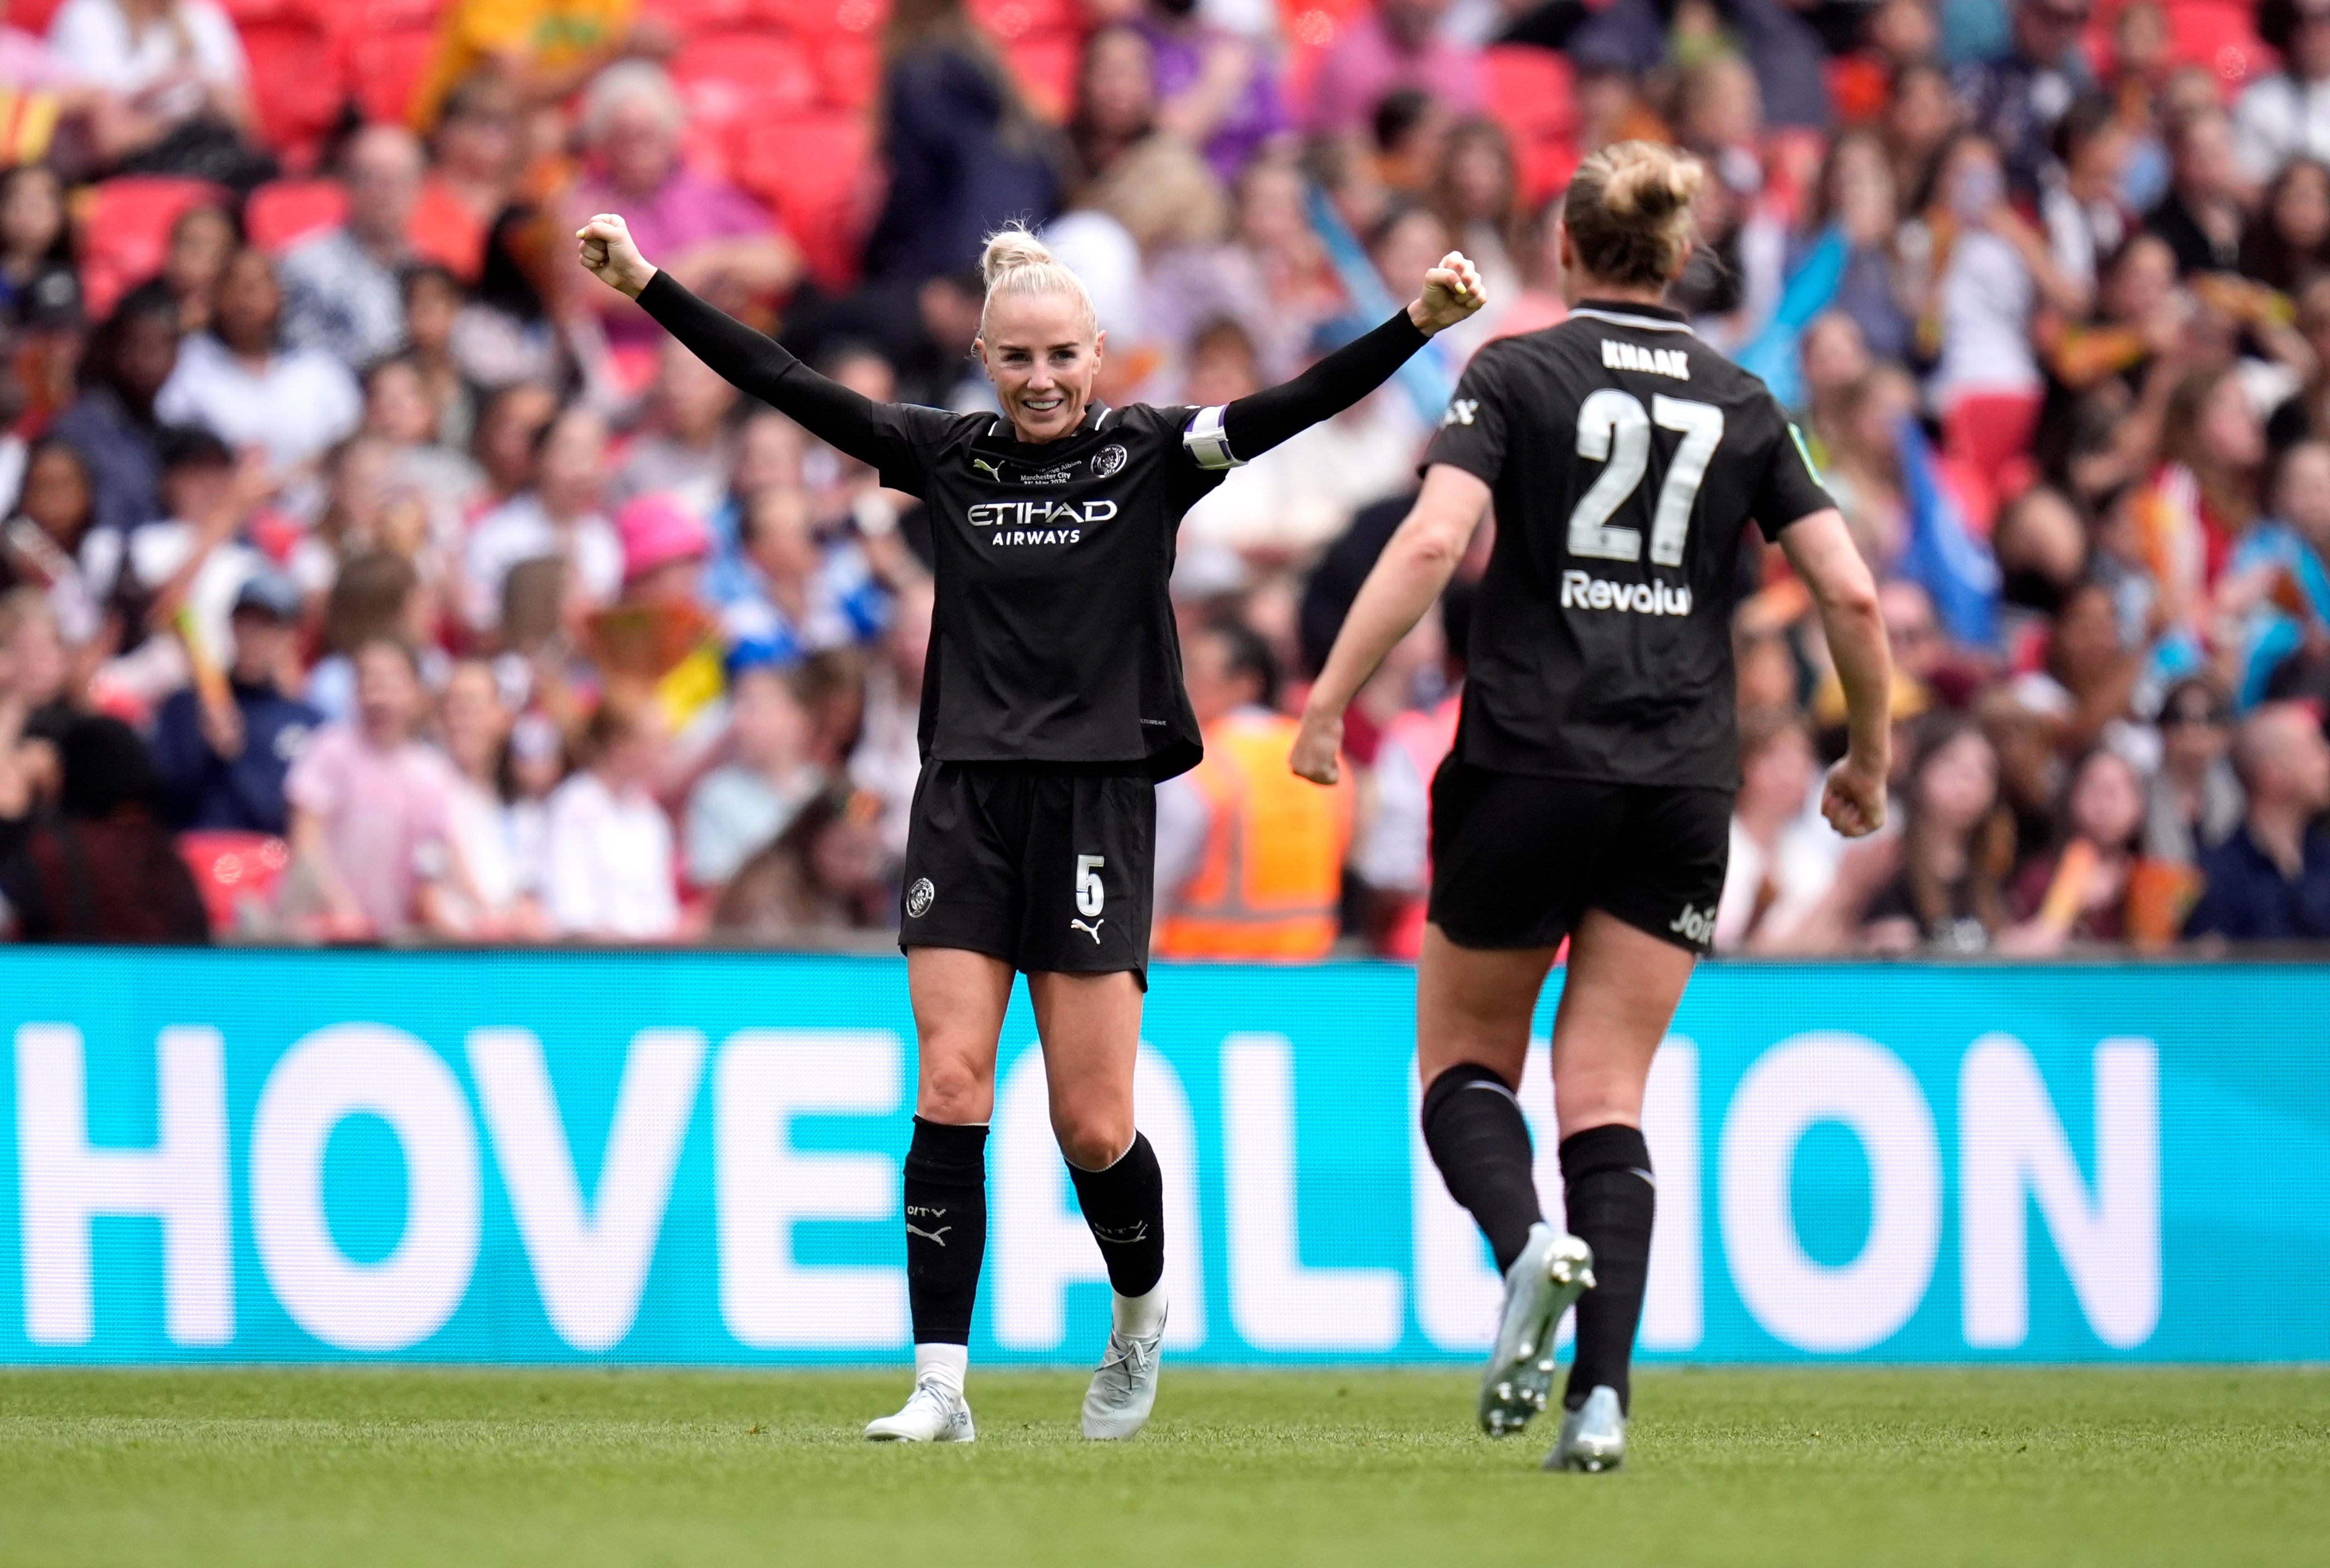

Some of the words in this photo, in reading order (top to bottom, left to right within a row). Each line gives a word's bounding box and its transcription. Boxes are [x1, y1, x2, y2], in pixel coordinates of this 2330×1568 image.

[1600, 338, 1691, 381] KNAAK
[1057, 472, 1071, 480] City
[1061, 460, 1082, 471] Albion
[1567, 388, 1724, 567] 27
[968, 501, 1117, 526] ETIHAD
[992, 530, 1080, 545] AIRWAYS
[1560, 569, 1693, 616] Revolu
[1076, 854, 1105, 917] 5
[1669, 902, 1716, 944] Joi
[14, 1022, 913, 1353] HOVE
[907, 1205, 946, 1218] CITY
